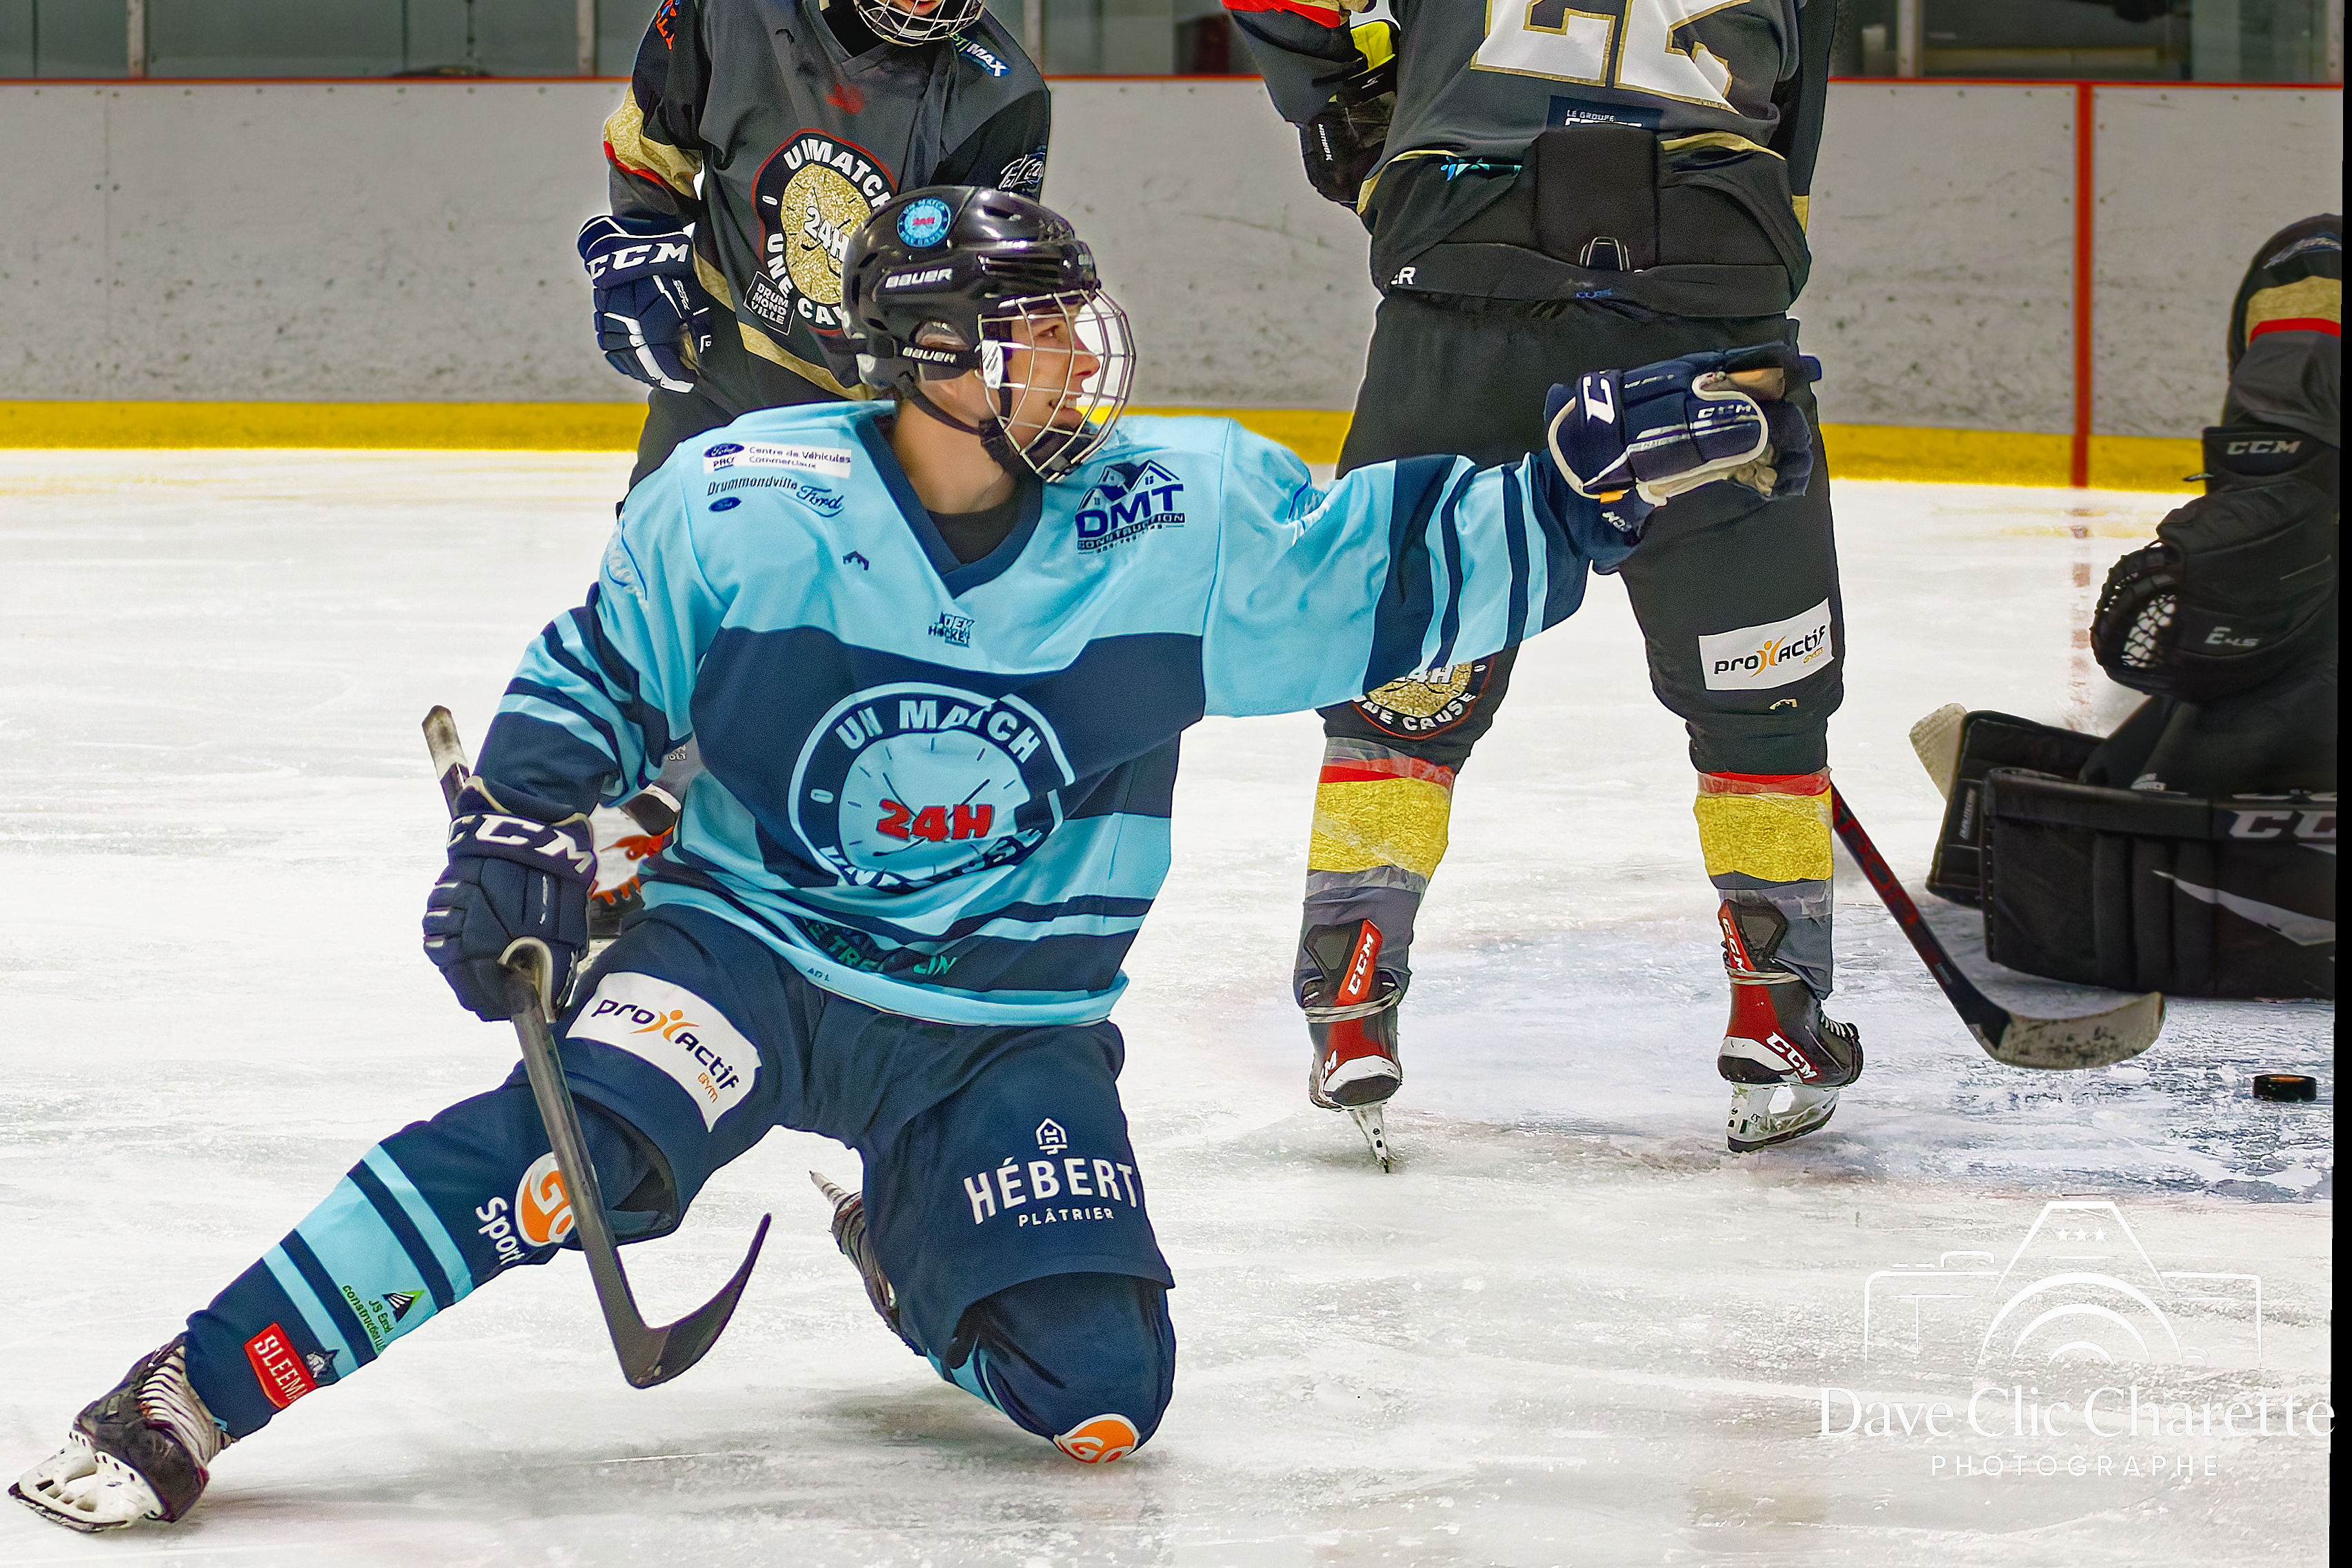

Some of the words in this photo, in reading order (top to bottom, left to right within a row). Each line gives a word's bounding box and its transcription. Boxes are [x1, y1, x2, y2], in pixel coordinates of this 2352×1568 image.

[587, 243, 689, 280] CCM
[750, 301, 786, 325] VILLE
[752, 292, 787, 316] MOND
[757, 283, 789, 308] DRUM
[2226, 441, 2302, 455] CCM
[707, 475, 798, 496] Drummondville
[1075, 483, 1184, 538] DMT
[1402, 692, 1477, 731] CAUSE
[875, 798, 993, 842] 24H
[446, 814, 594, 874] CCM
[1347, 932, 1374, 996] CCM
[1766, 1030, 1818, 1079] CCM
[963, 1156, 1137, 1225] HÉBERT
[1018, 1207, 1115, 1227] PLÂTRIER
